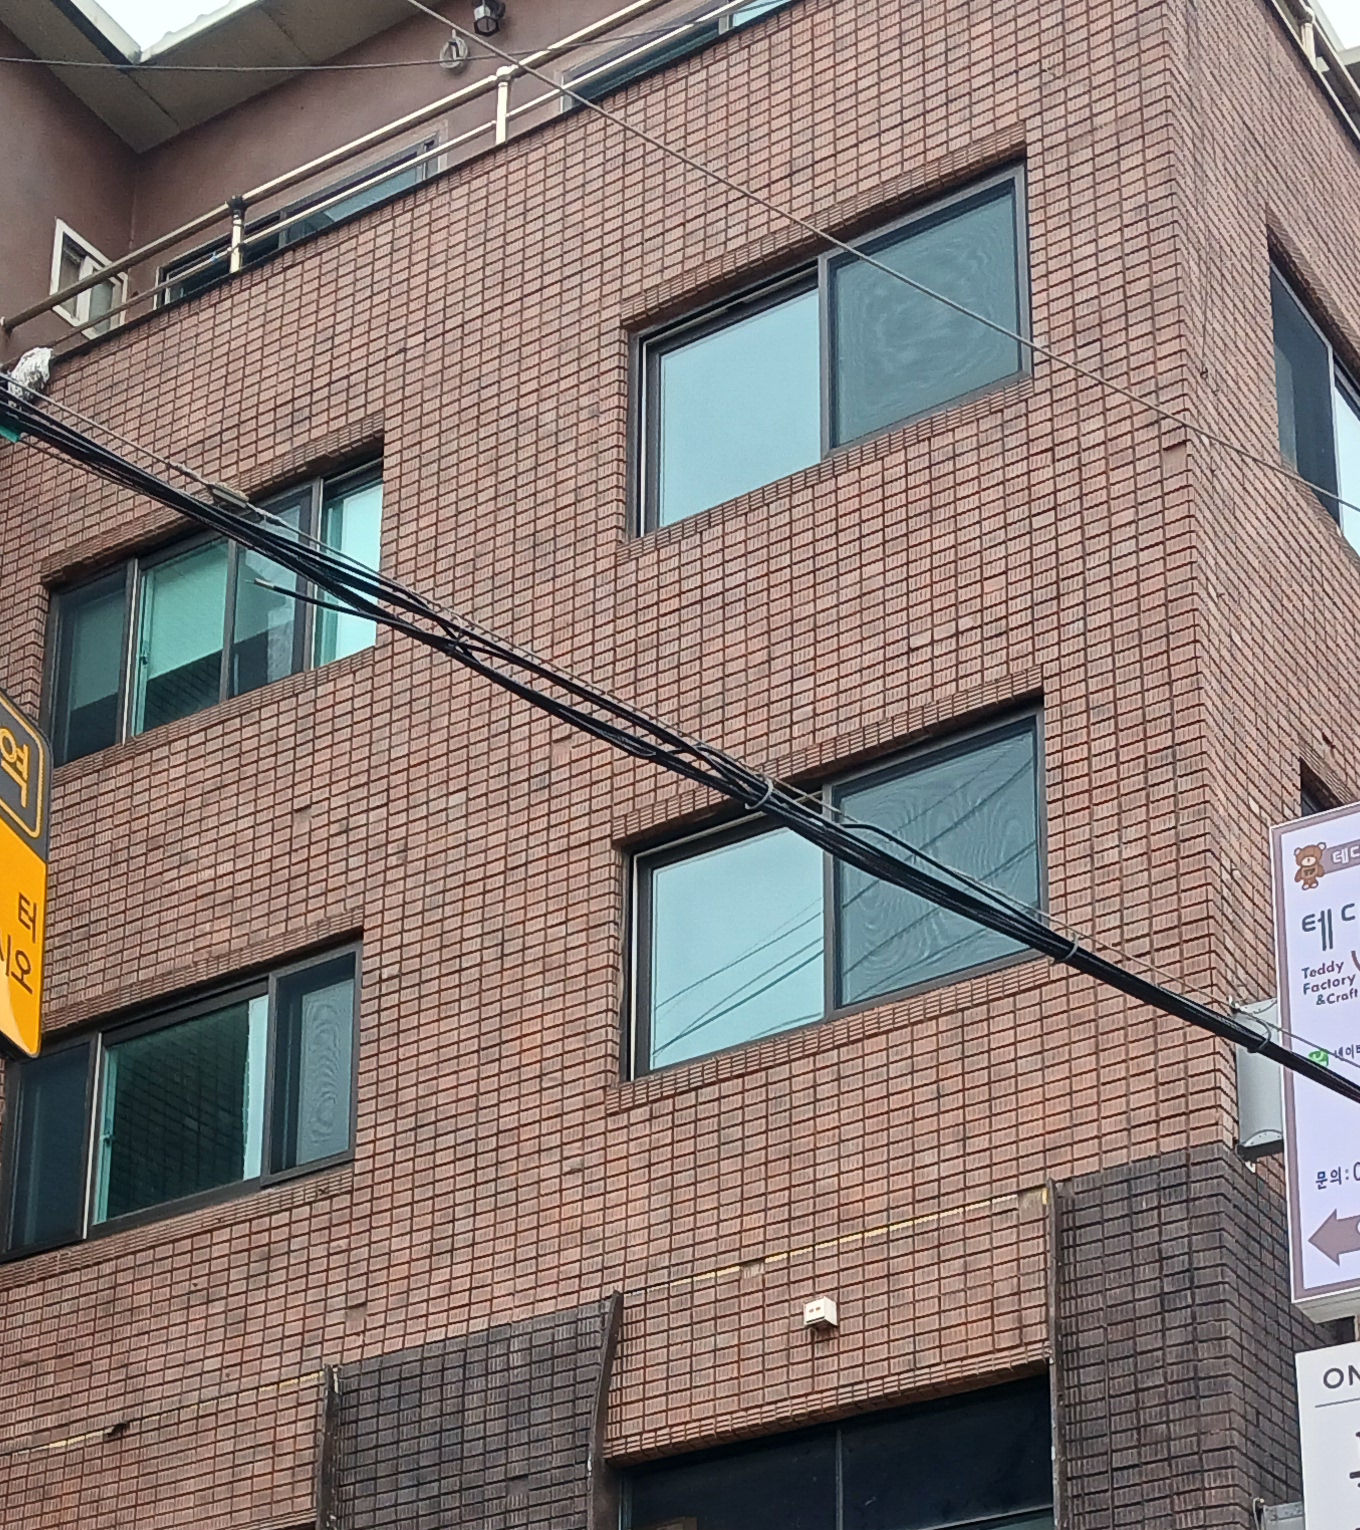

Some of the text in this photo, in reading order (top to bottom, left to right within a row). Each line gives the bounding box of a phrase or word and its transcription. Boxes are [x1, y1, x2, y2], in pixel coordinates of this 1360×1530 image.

[1301, 960, 1344, 979] Teddy
[1303, 974, 1356, 994] Factory
[1315, 988, 1358, 1005] &Craft
